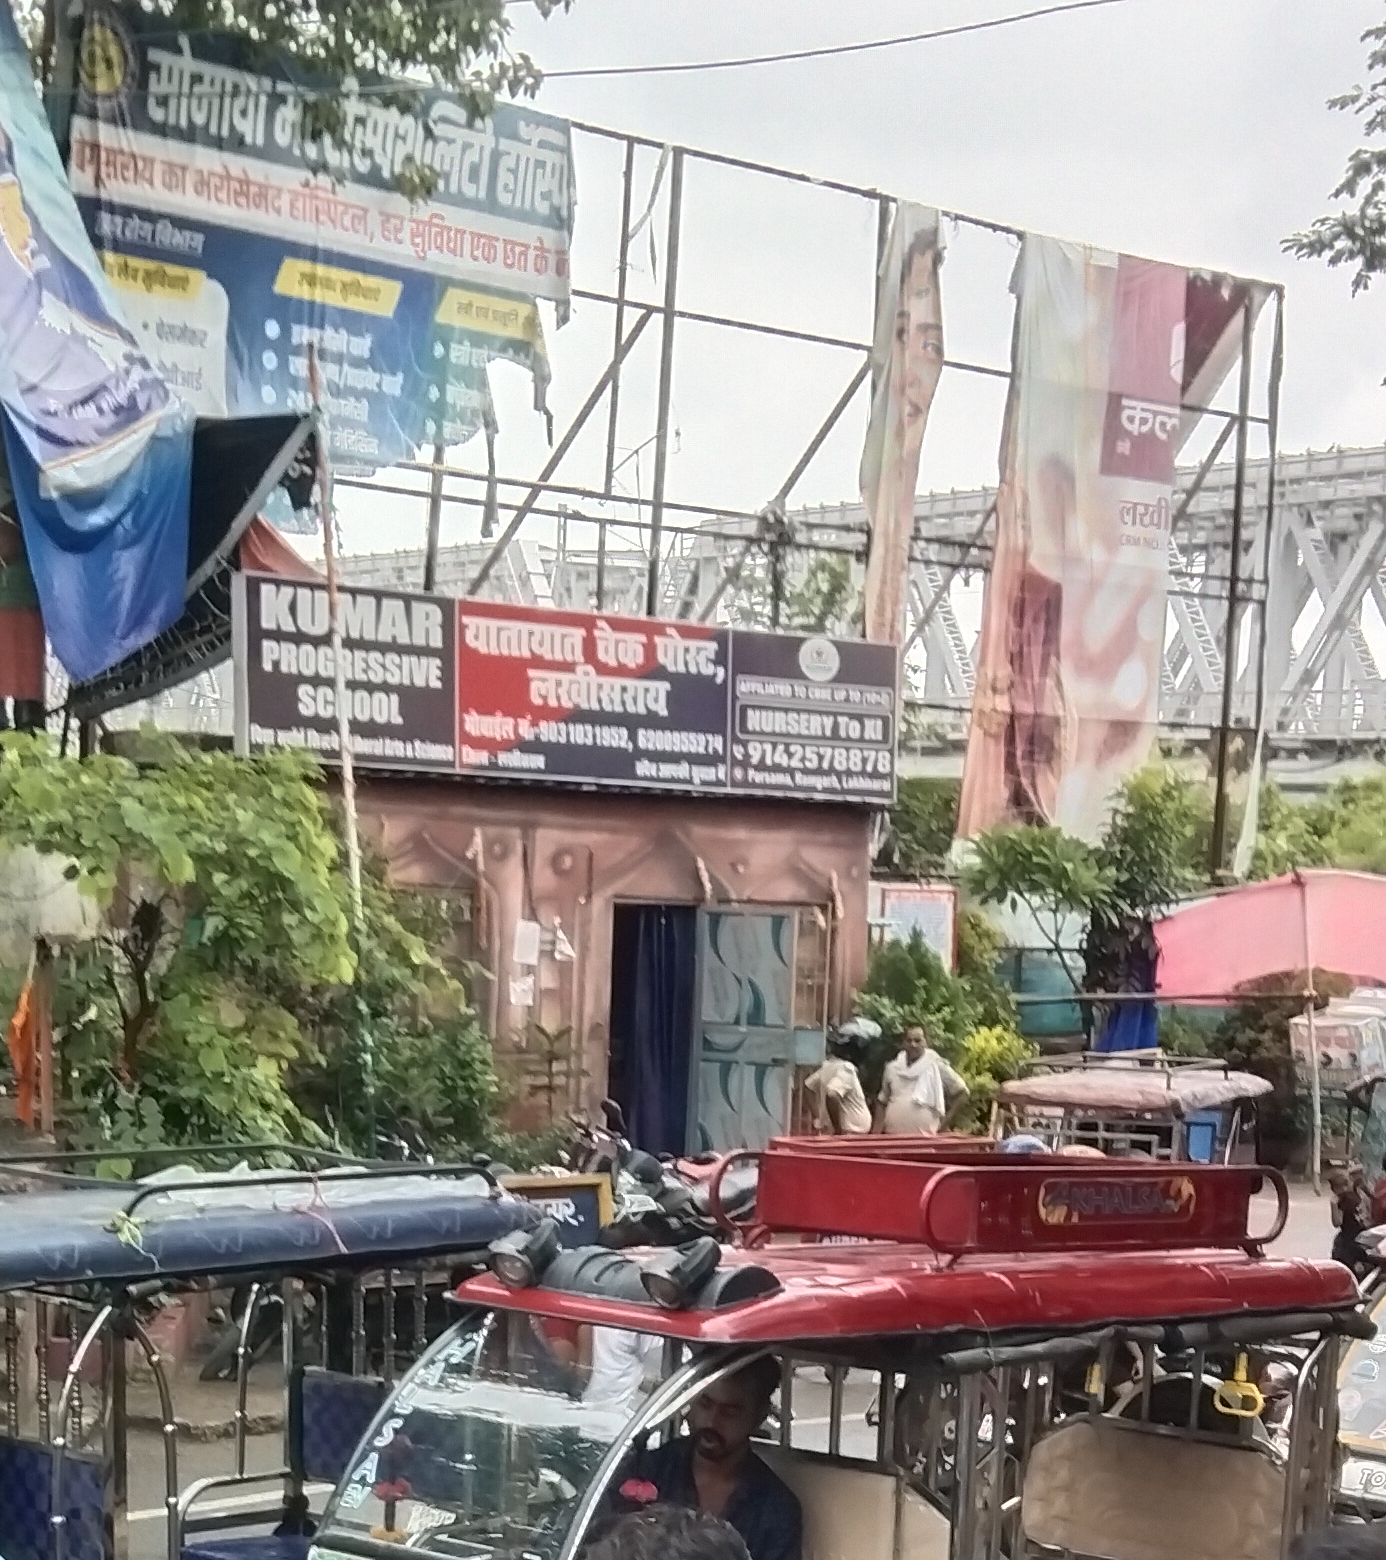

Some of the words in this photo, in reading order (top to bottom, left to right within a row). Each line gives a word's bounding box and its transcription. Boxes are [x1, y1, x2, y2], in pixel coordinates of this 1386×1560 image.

[259, 581, 444, 649] KUMAR
[261, 638, 443, 689] PROGRESSIVE
[462, 615, 587, 663] यातायात
[593, 619, 647, 669] चेक
[527, 664, 671, 717] लखीसराय
[746, 707, 834, 738] NURSERY
[837, 715, 862, 739] To
[747, 741, 892, 774] 9142578878
